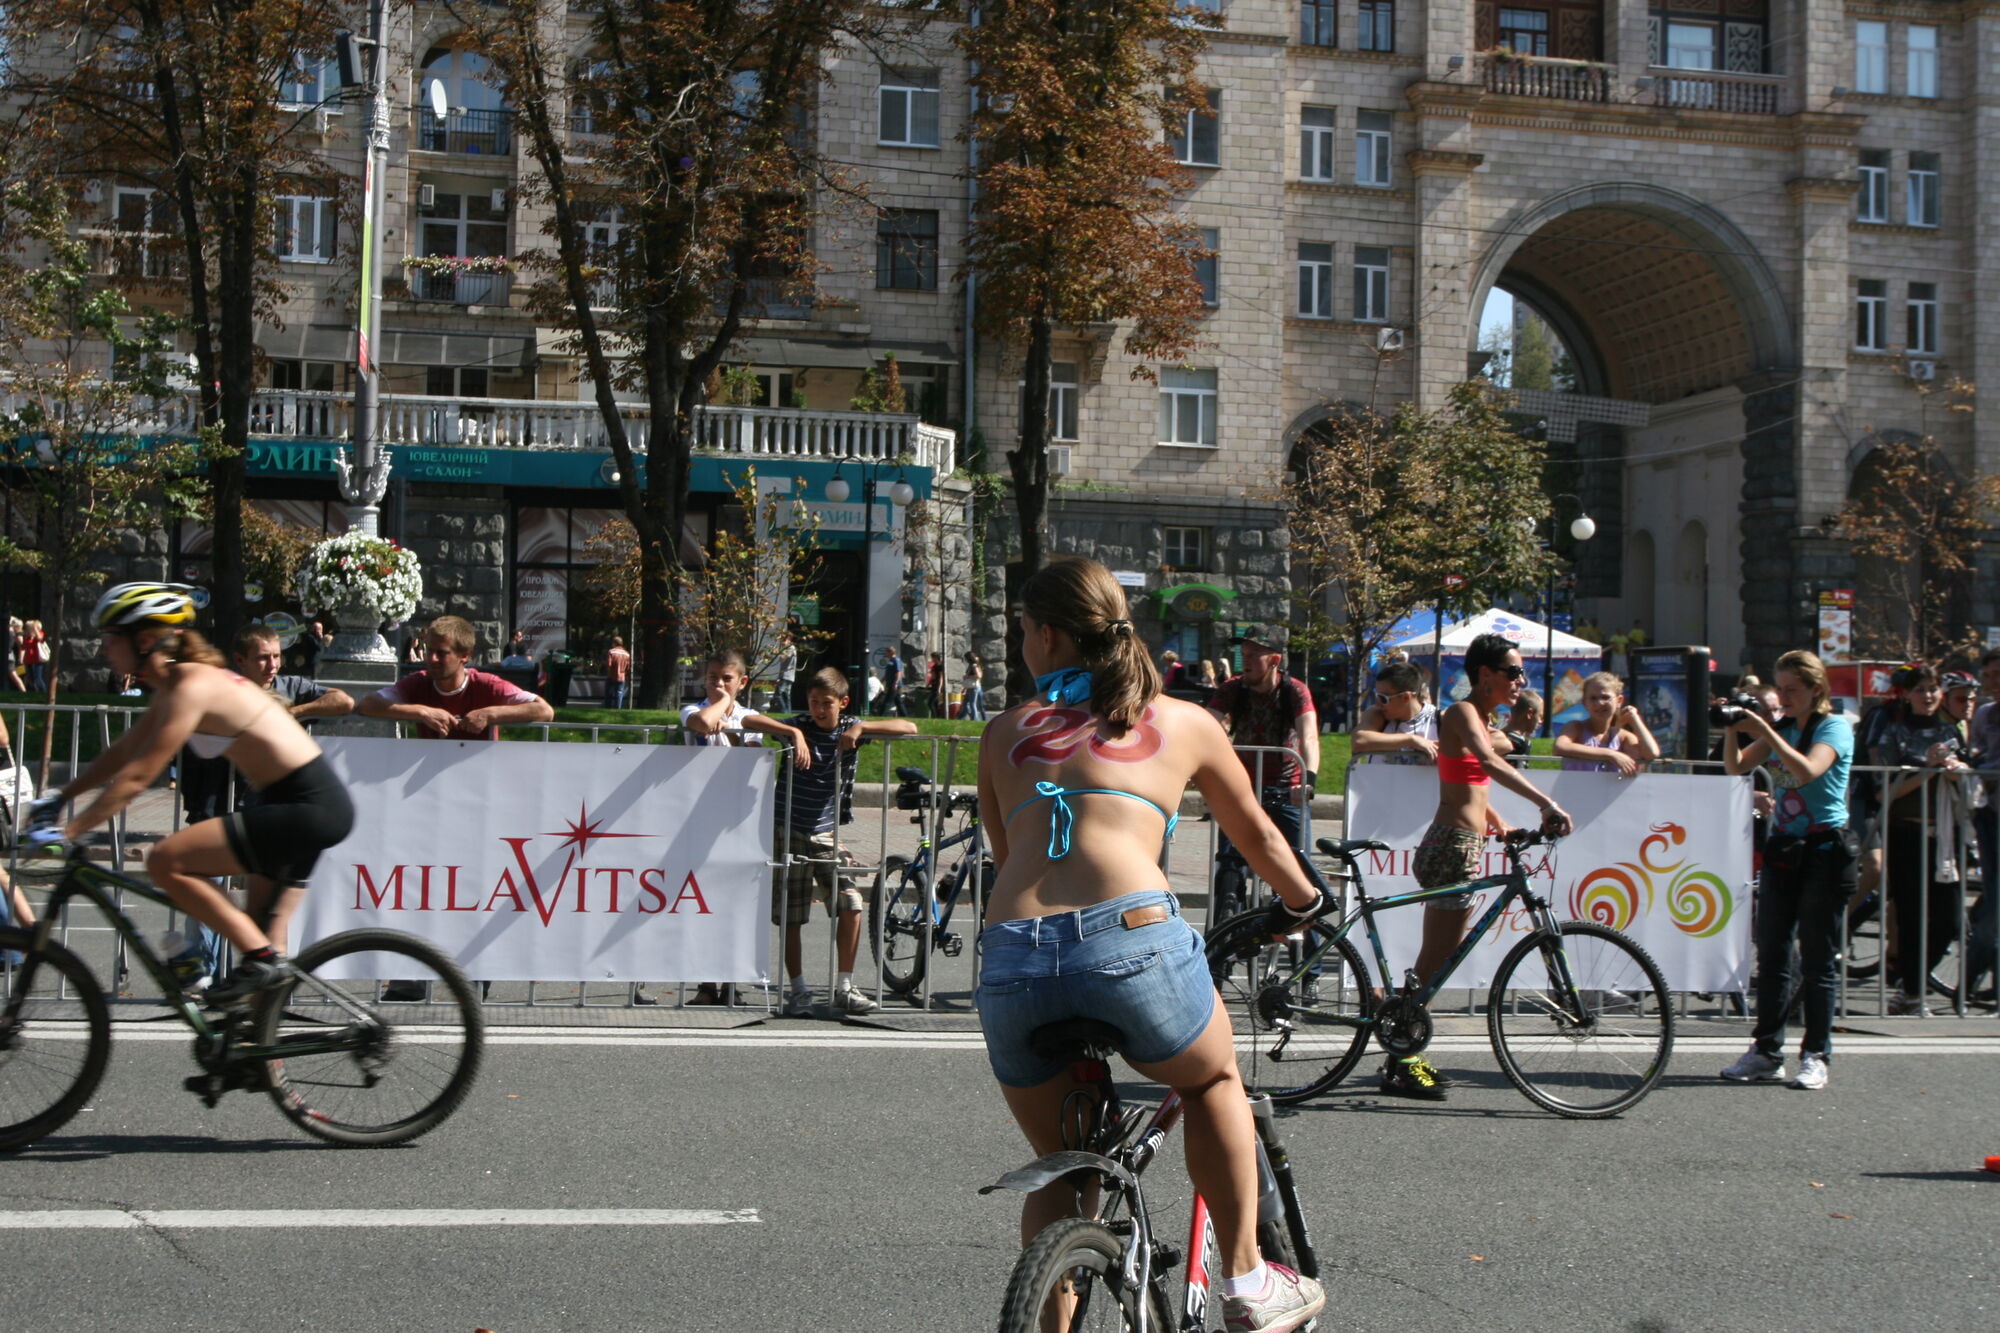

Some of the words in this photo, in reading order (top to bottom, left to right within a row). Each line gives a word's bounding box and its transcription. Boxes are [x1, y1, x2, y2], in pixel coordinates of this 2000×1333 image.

[410, 450, 488, 464] ЮВЕЛІРНИЙ
[425, 465, 472, 478] САЛОН
[1368, 849, 1555, 879] MIITSA
[351, 837, 713, 928] MILAVITSA
